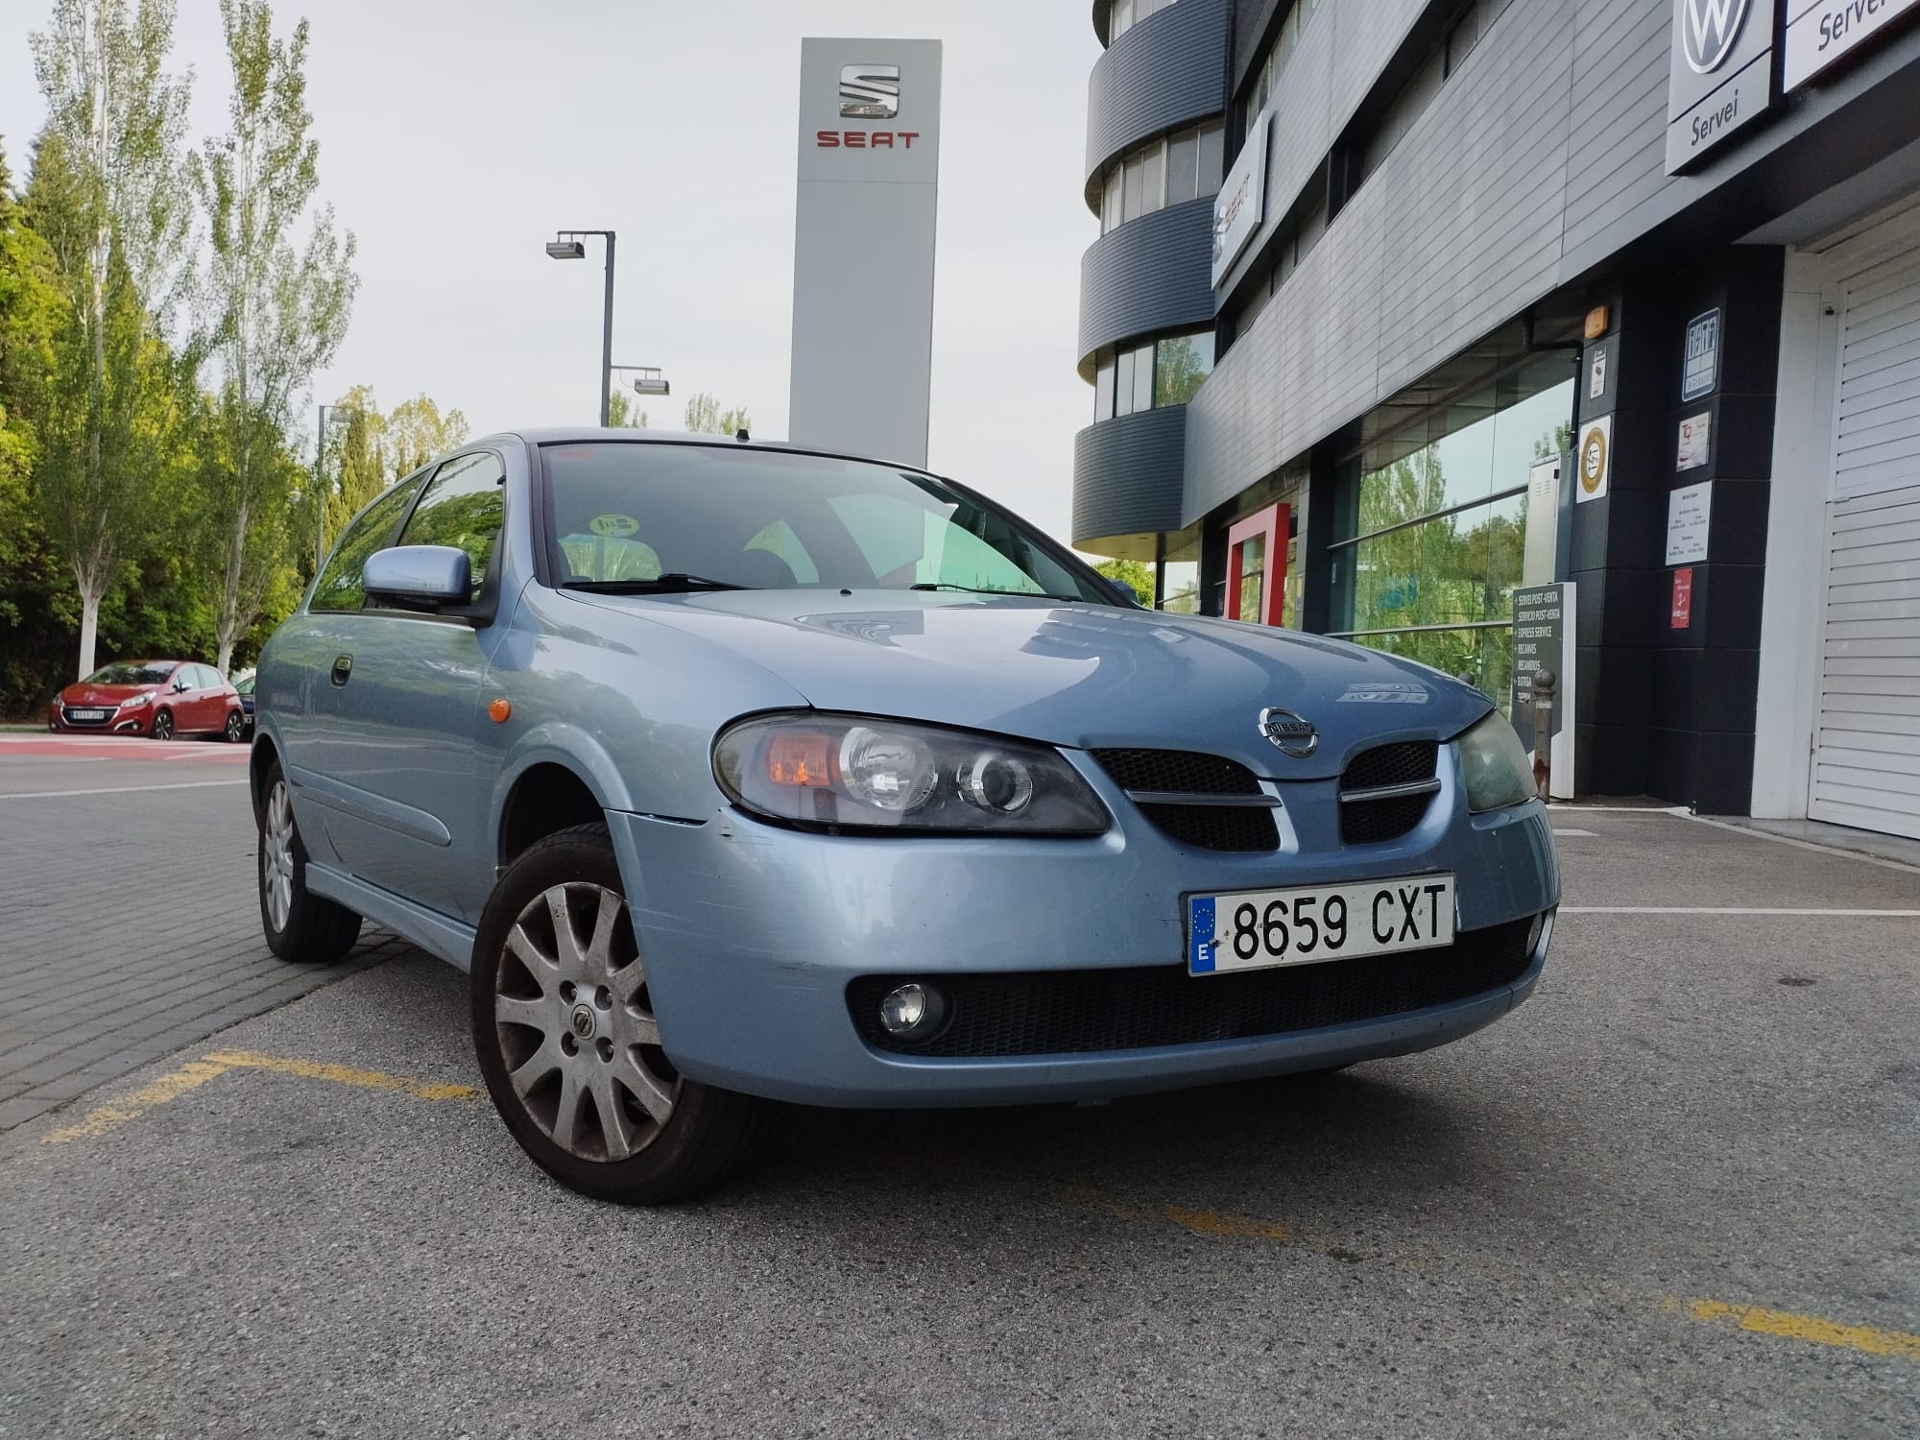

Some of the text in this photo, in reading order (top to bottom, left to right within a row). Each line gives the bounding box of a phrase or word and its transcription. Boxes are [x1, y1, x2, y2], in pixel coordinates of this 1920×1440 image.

[1818, 0, 1885, 51] Serve
[817, 131, 919, 149] SEAT
[1691, 89, 1738, 146] Servei
[1267, 723, 1312, 732] NISSAN
[1198, 884, 1446, 960] E 8659 CXT
